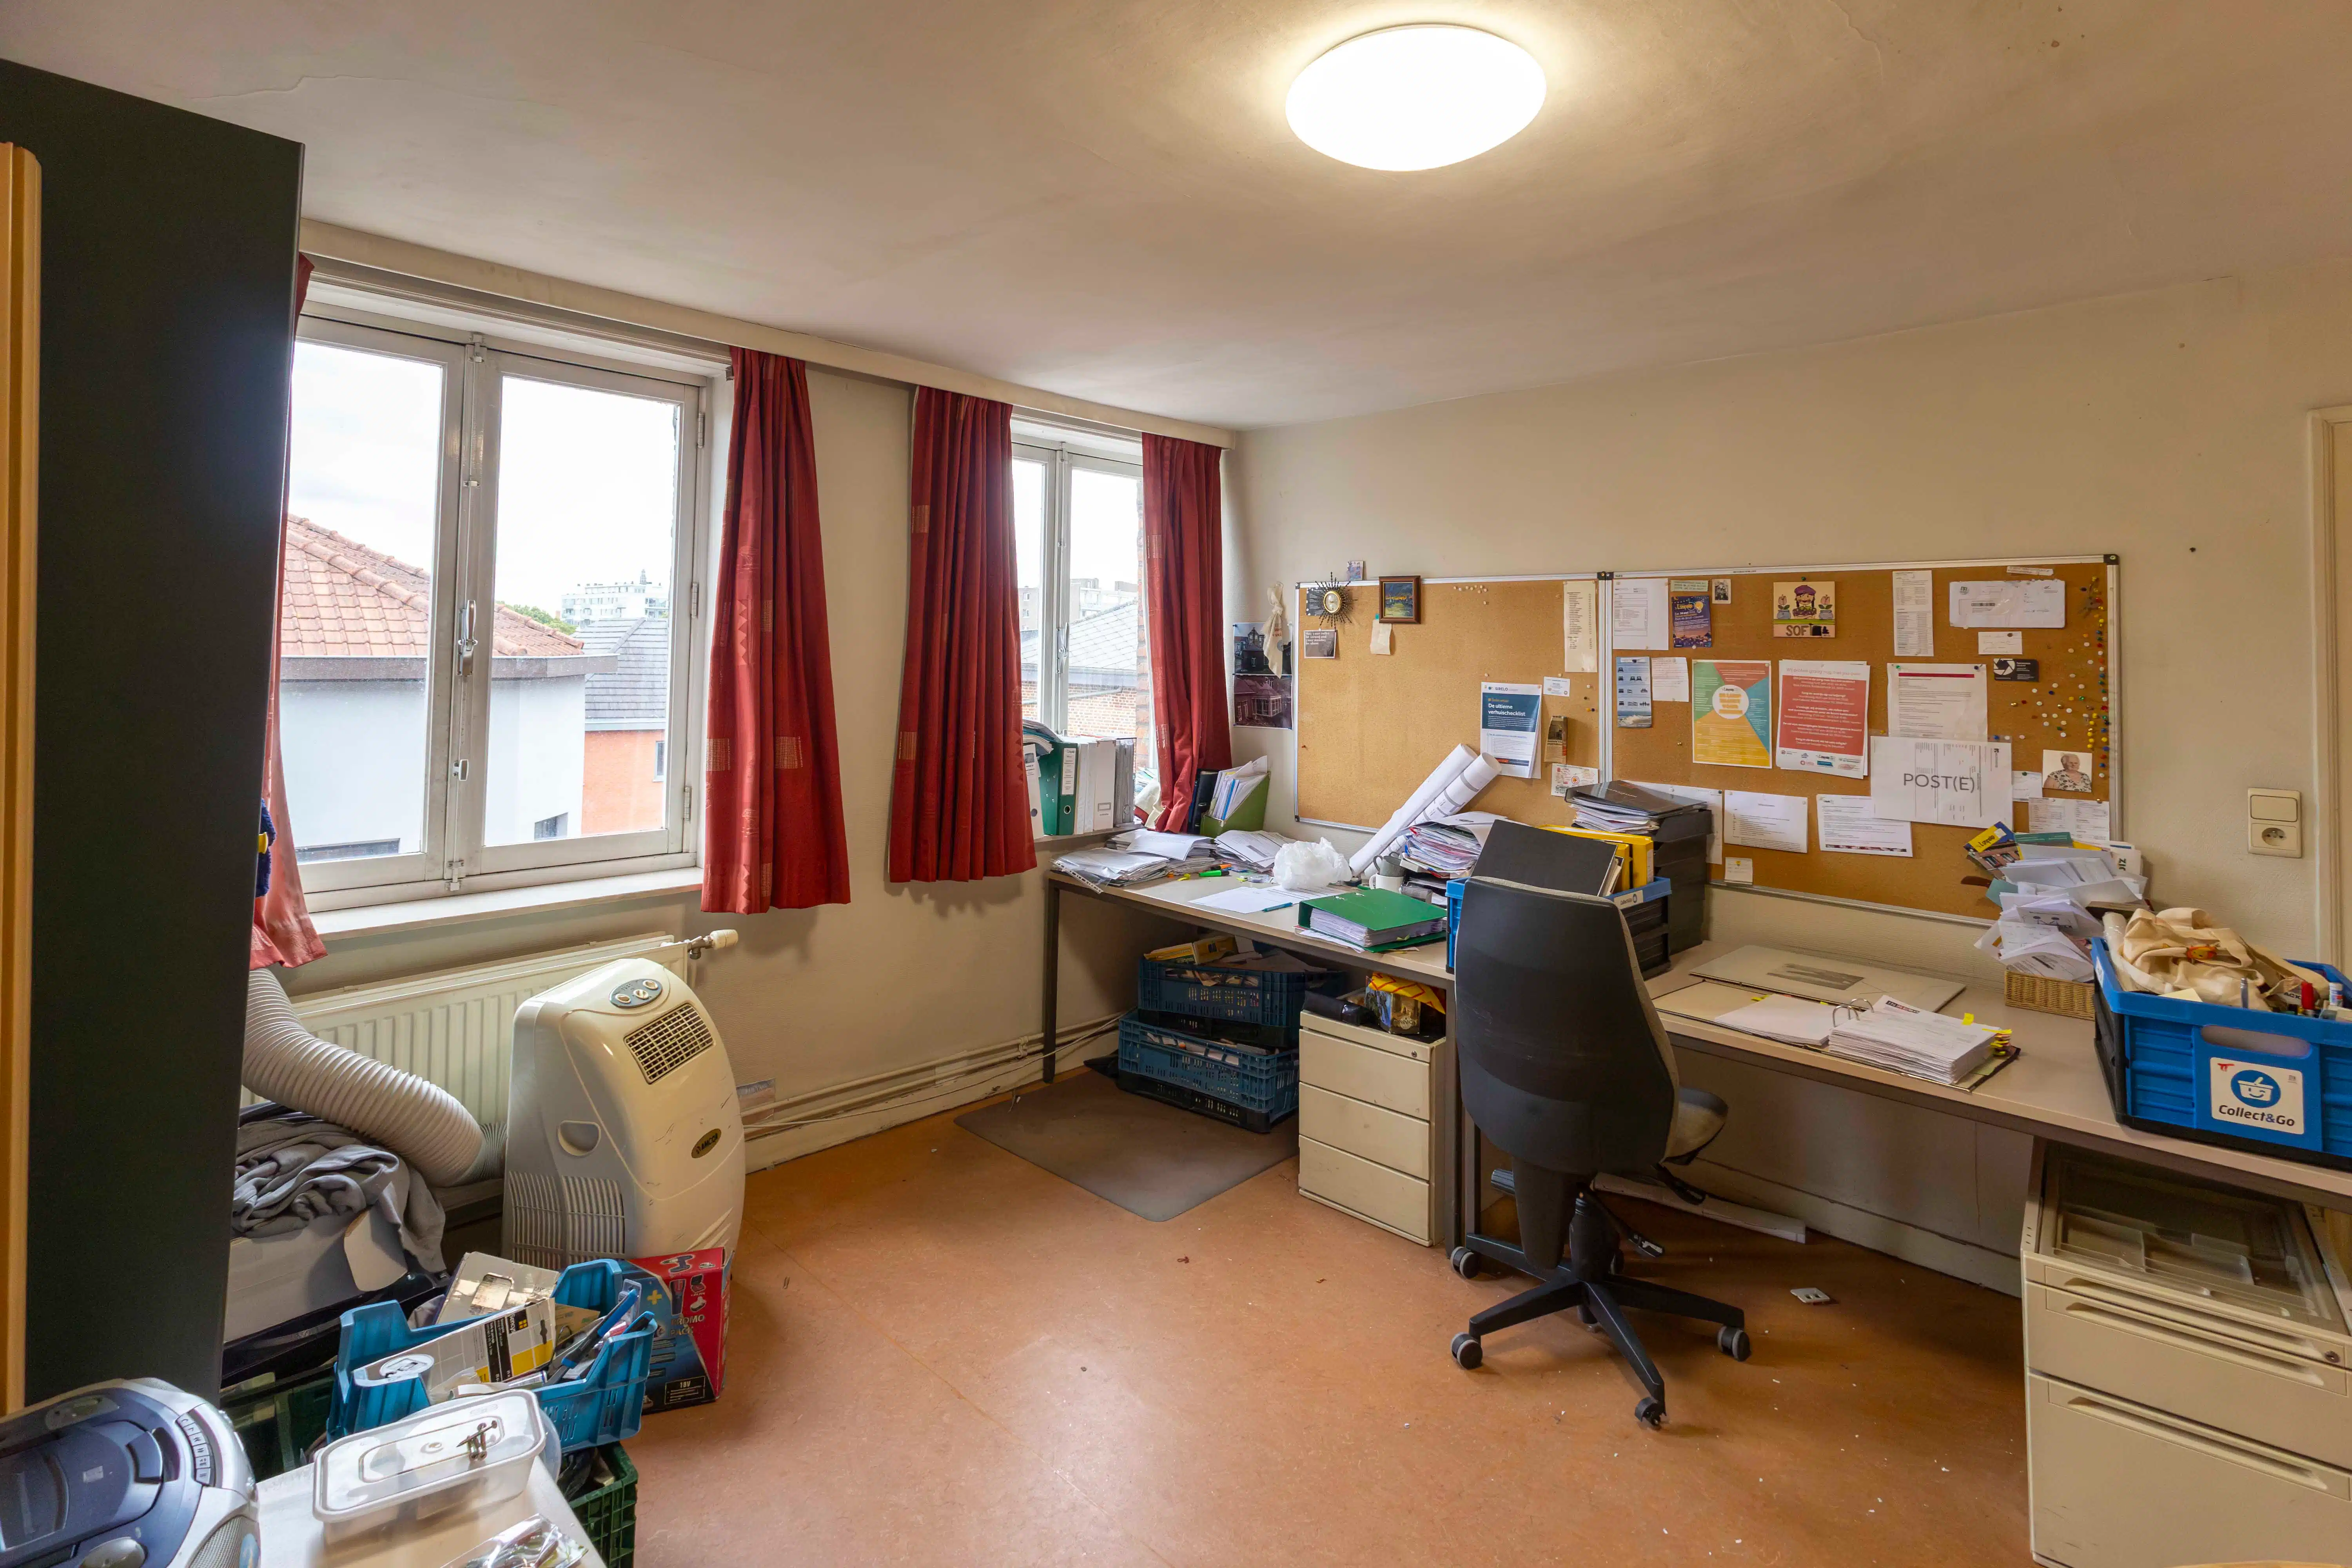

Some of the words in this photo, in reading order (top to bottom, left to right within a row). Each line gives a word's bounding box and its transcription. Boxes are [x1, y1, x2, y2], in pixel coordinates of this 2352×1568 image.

[1903, 773, 1975, 793] POST(E)
[2219, 1104, 2295, 1127] Collect&Go
[671, 1314, 706, 1325] PROMO
